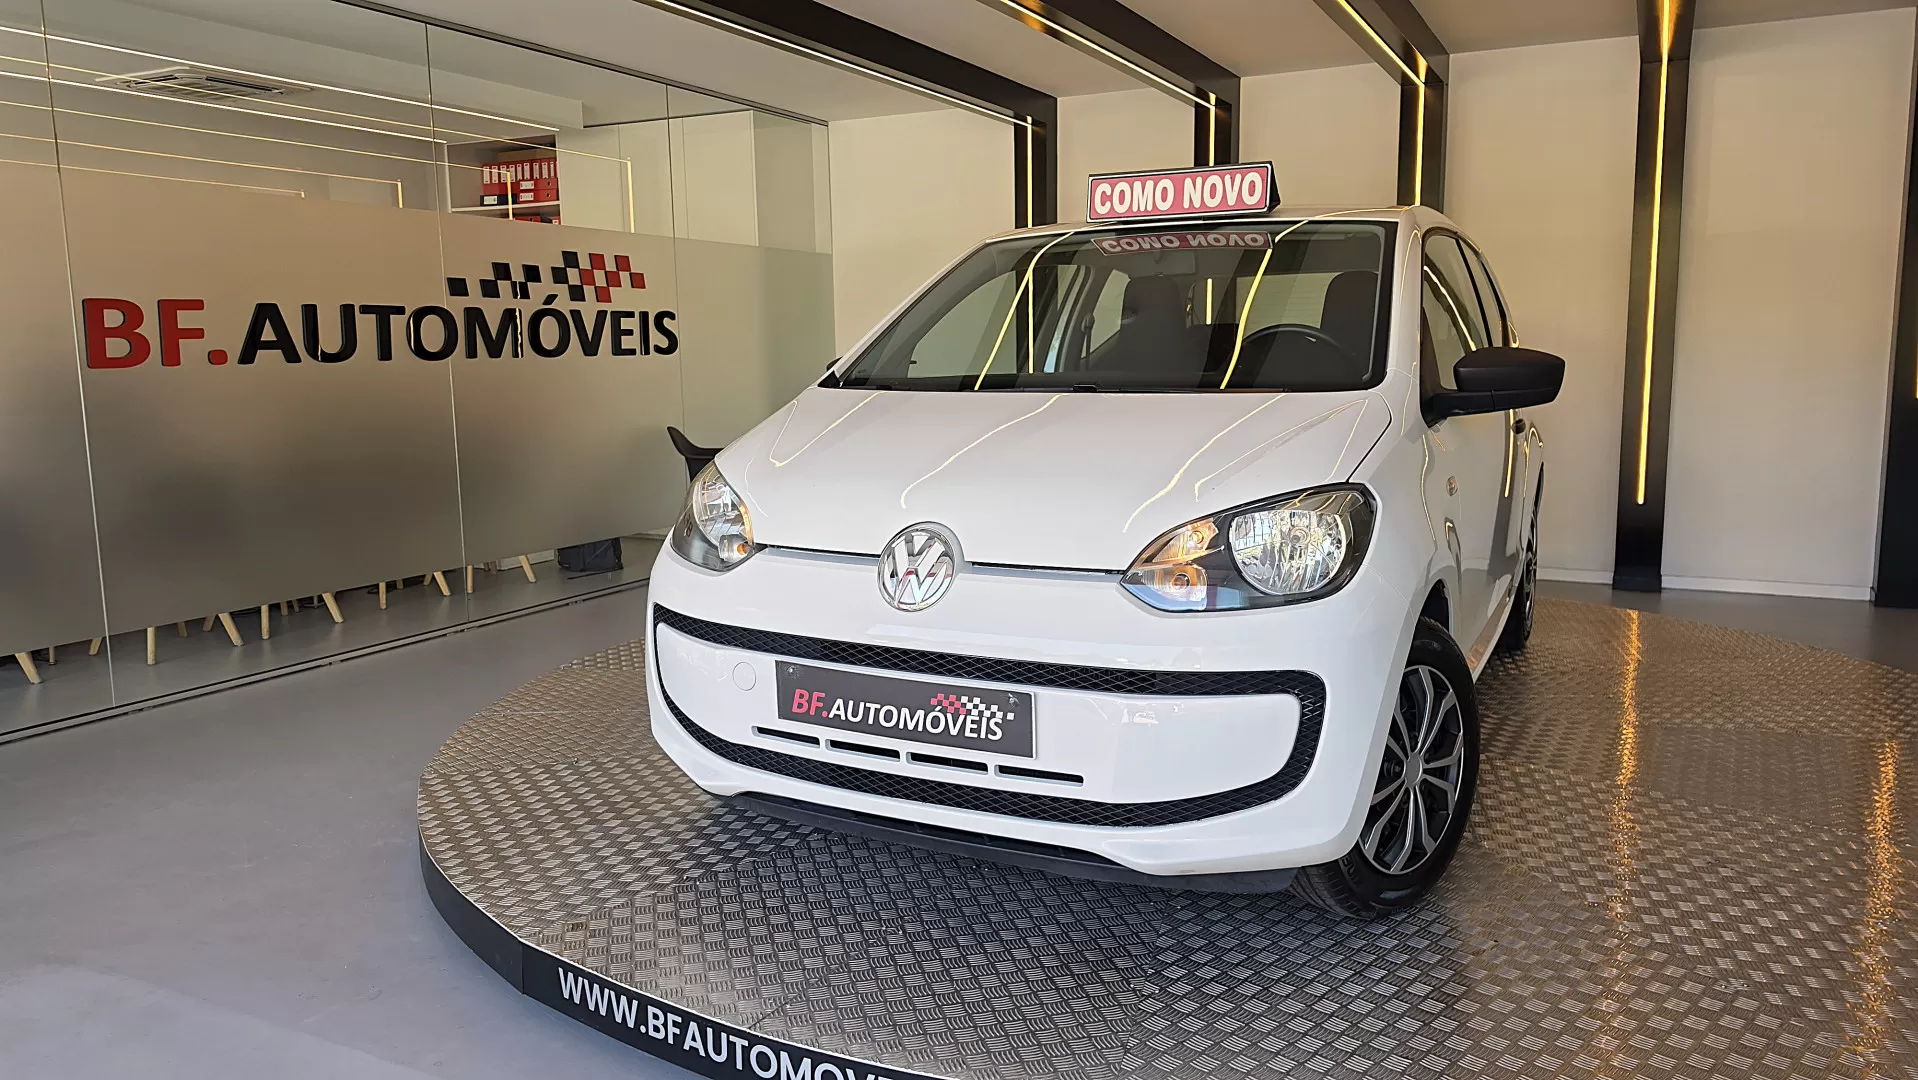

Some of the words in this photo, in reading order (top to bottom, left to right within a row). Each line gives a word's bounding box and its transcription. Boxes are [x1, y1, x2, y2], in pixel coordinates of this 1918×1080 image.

[1094, 178, 1175, 215] COMO
[1183, 171, 1263, 209] NOVO
[82, 293, 679, 370] BF.AUTOMÓVEIS
[791, 688, 1003, 741] BF.AUTOMÓVEIS
[557, 966, 894, 1080] WWW.BFAUTOMO
